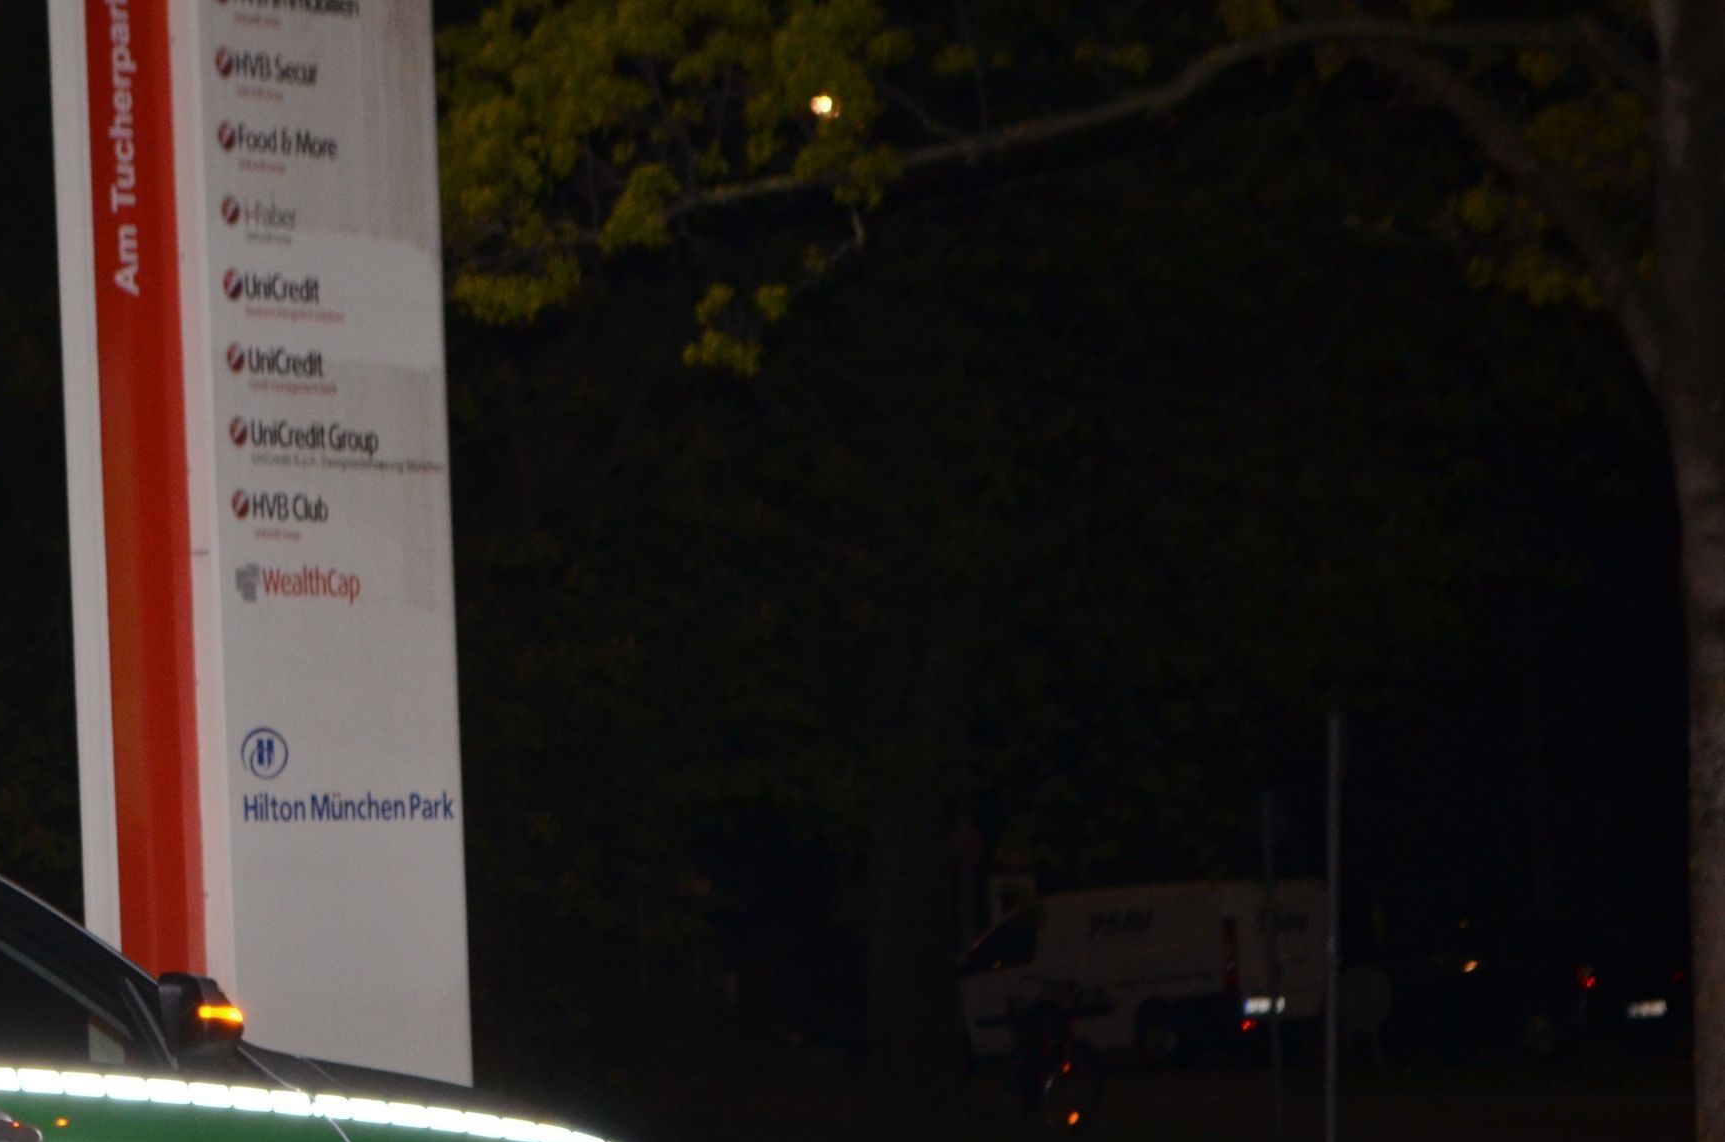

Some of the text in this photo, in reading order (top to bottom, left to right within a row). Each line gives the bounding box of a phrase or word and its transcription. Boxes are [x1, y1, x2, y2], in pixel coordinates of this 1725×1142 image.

[235, 52, 272, 81] HVB
[105, 0, 141, 296] Am Tucherpar
[238, 128, 276, 155] Food
[295, 134, 338, 161] More
[244, 269, 320, 304] UniCredit
[248, 346, 323, 377] UniCredit
[251, 418, 379, 457] UniCredit Group
[252, 491, 329, 524] HVB Club
[262, 565, 361, 604] WealthCap
[243, 789, 454, 822] Hilton München Park
